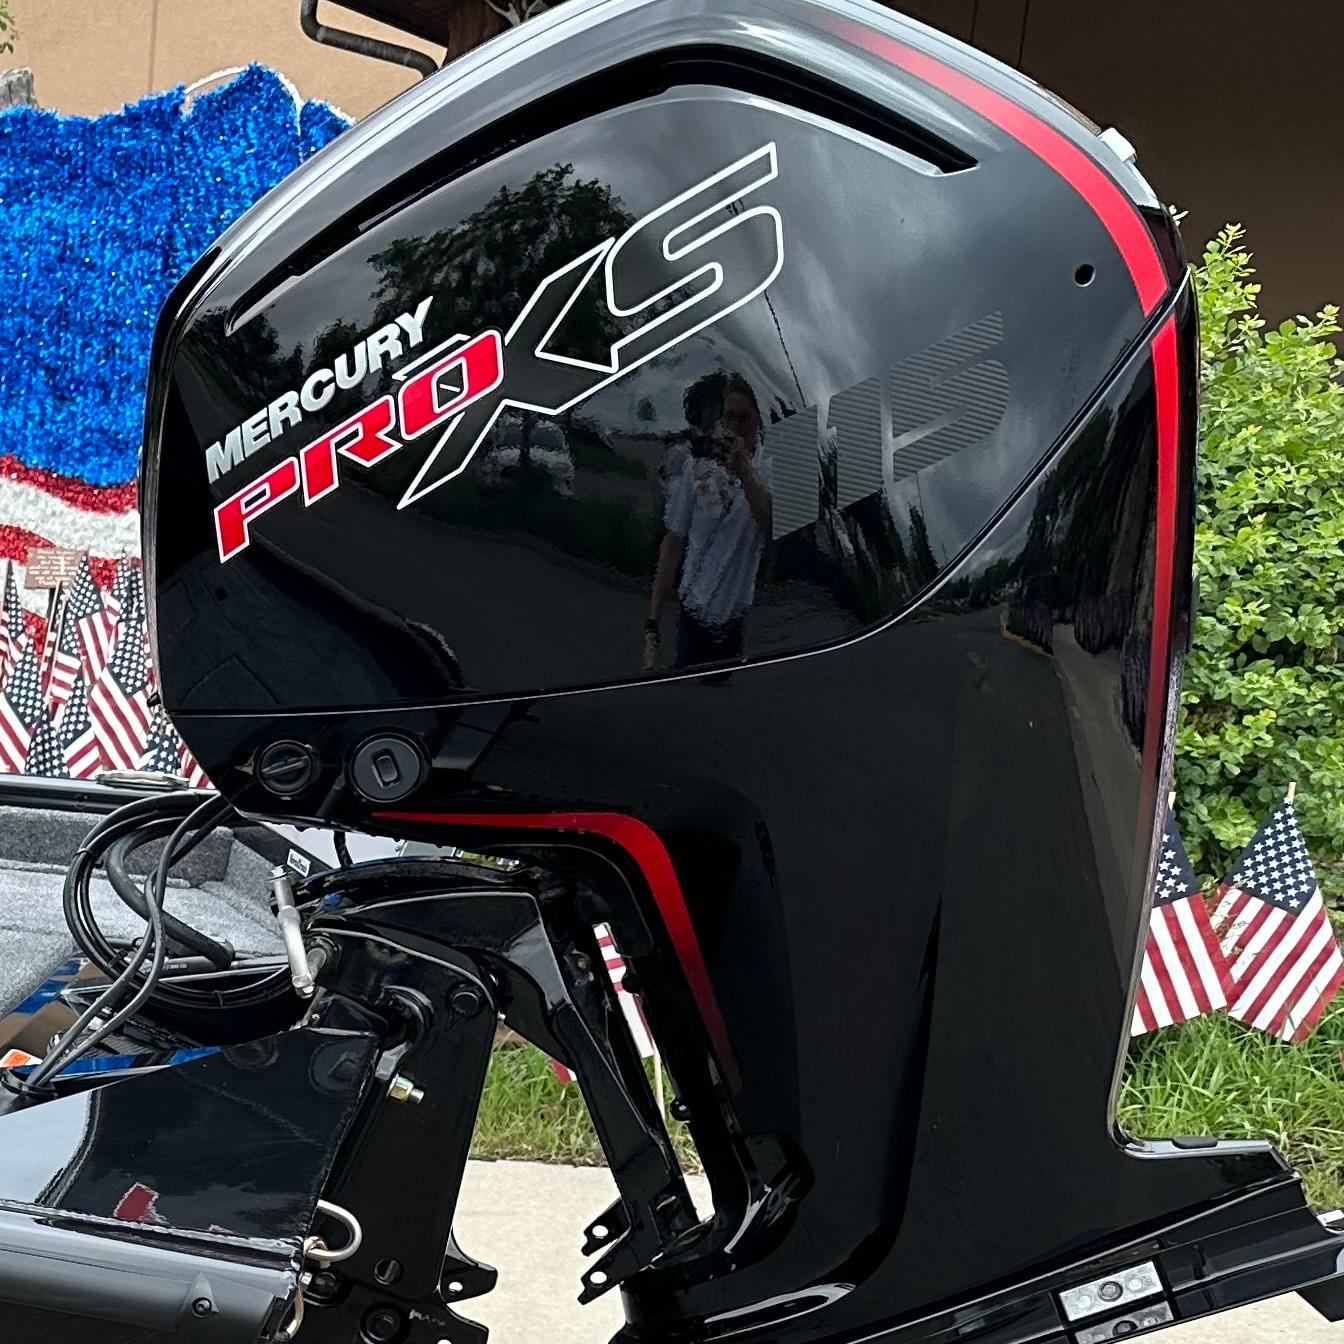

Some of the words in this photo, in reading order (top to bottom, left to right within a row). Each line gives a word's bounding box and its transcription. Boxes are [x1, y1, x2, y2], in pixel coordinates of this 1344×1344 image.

[205, 297, 434, 484] MERCURY
[212, 329, 503, 564] PRO
[398, 142, 784, 510] XS
